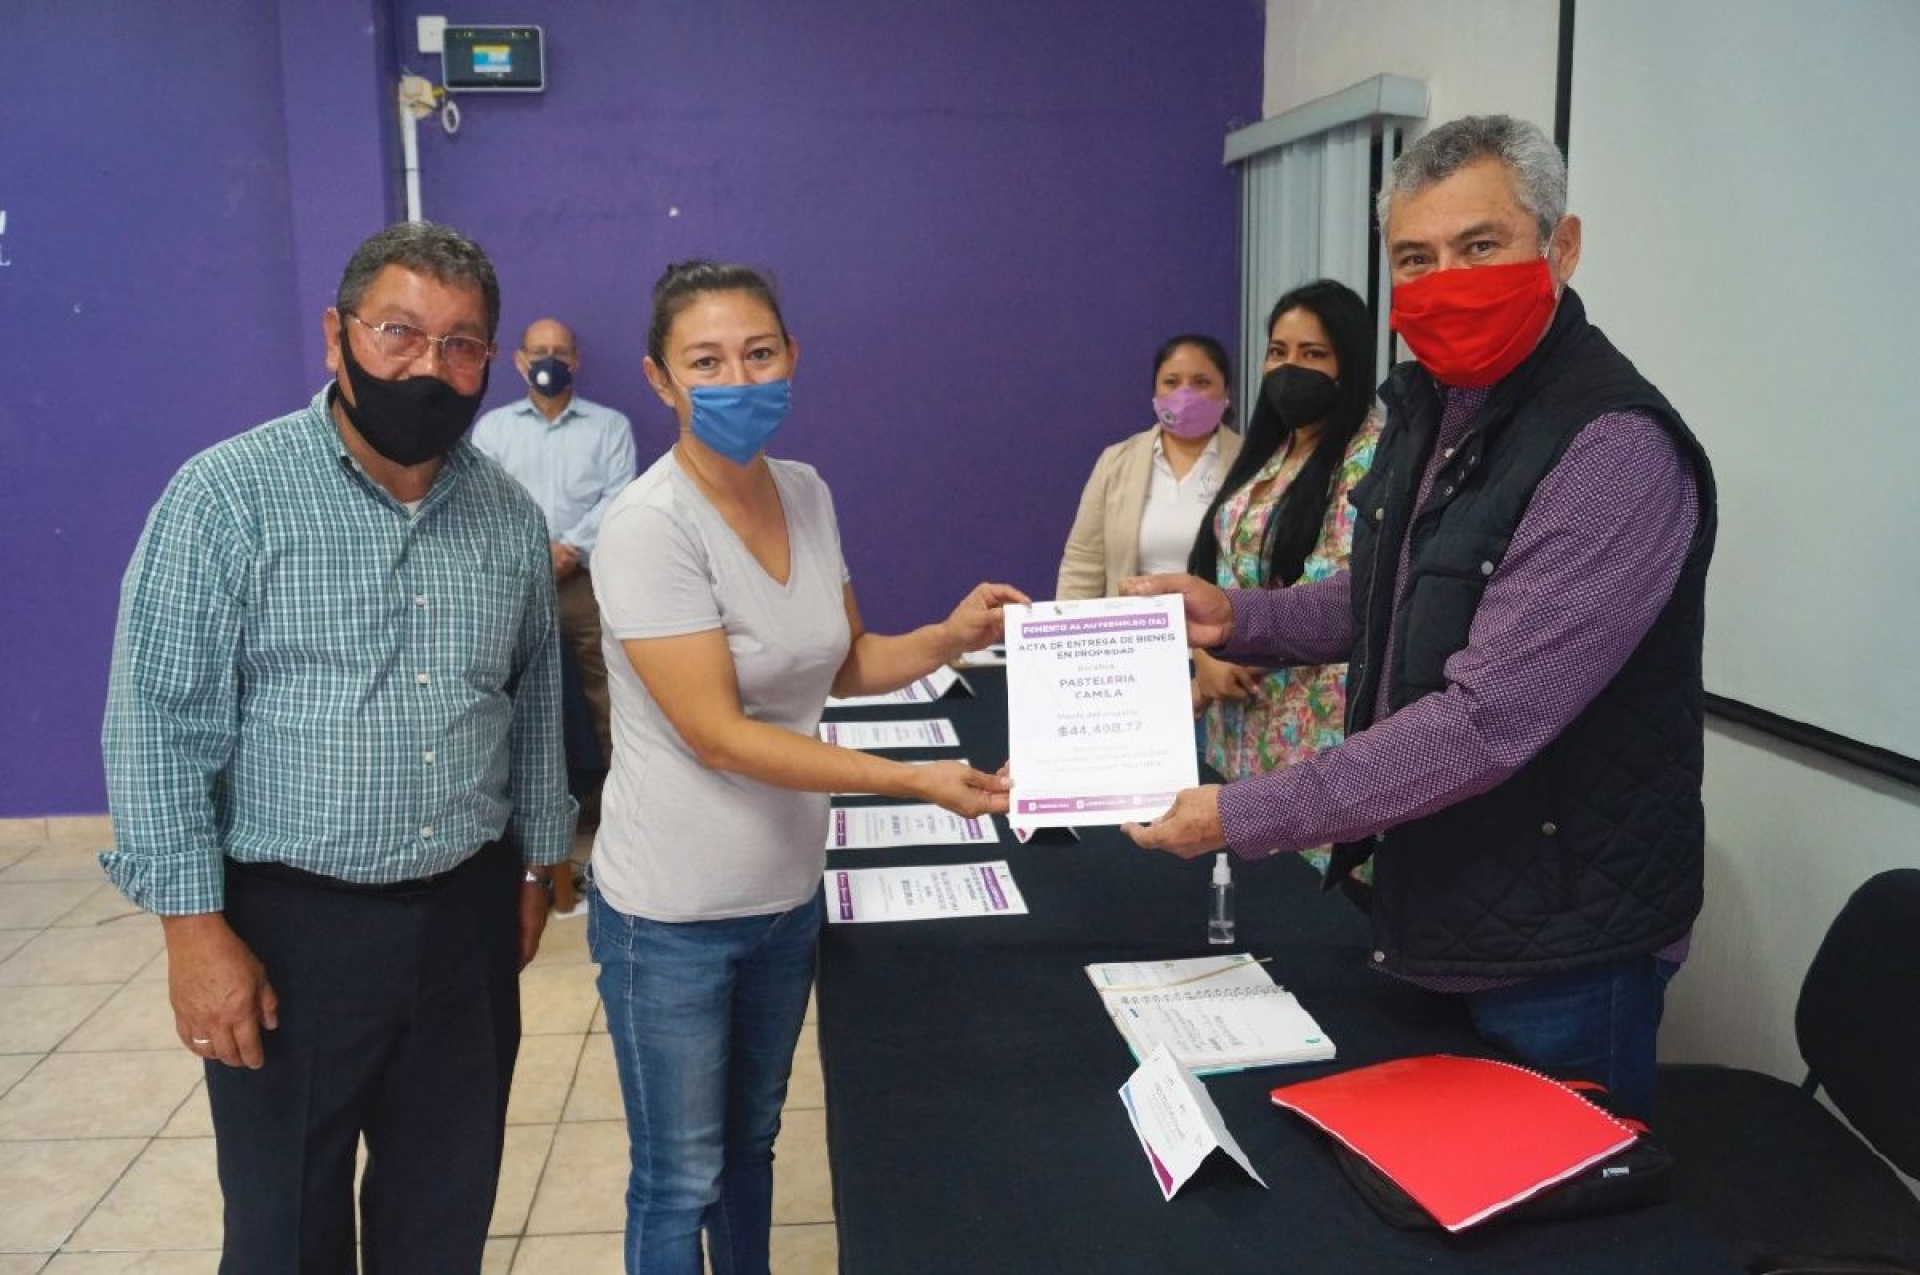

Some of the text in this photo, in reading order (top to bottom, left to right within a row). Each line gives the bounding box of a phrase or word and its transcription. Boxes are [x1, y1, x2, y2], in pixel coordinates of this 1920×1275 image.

[1018, 632, 1176, 652] ACTA DE ENTREGA DE BIENES
[1057, 650, 1072, 660] EN
